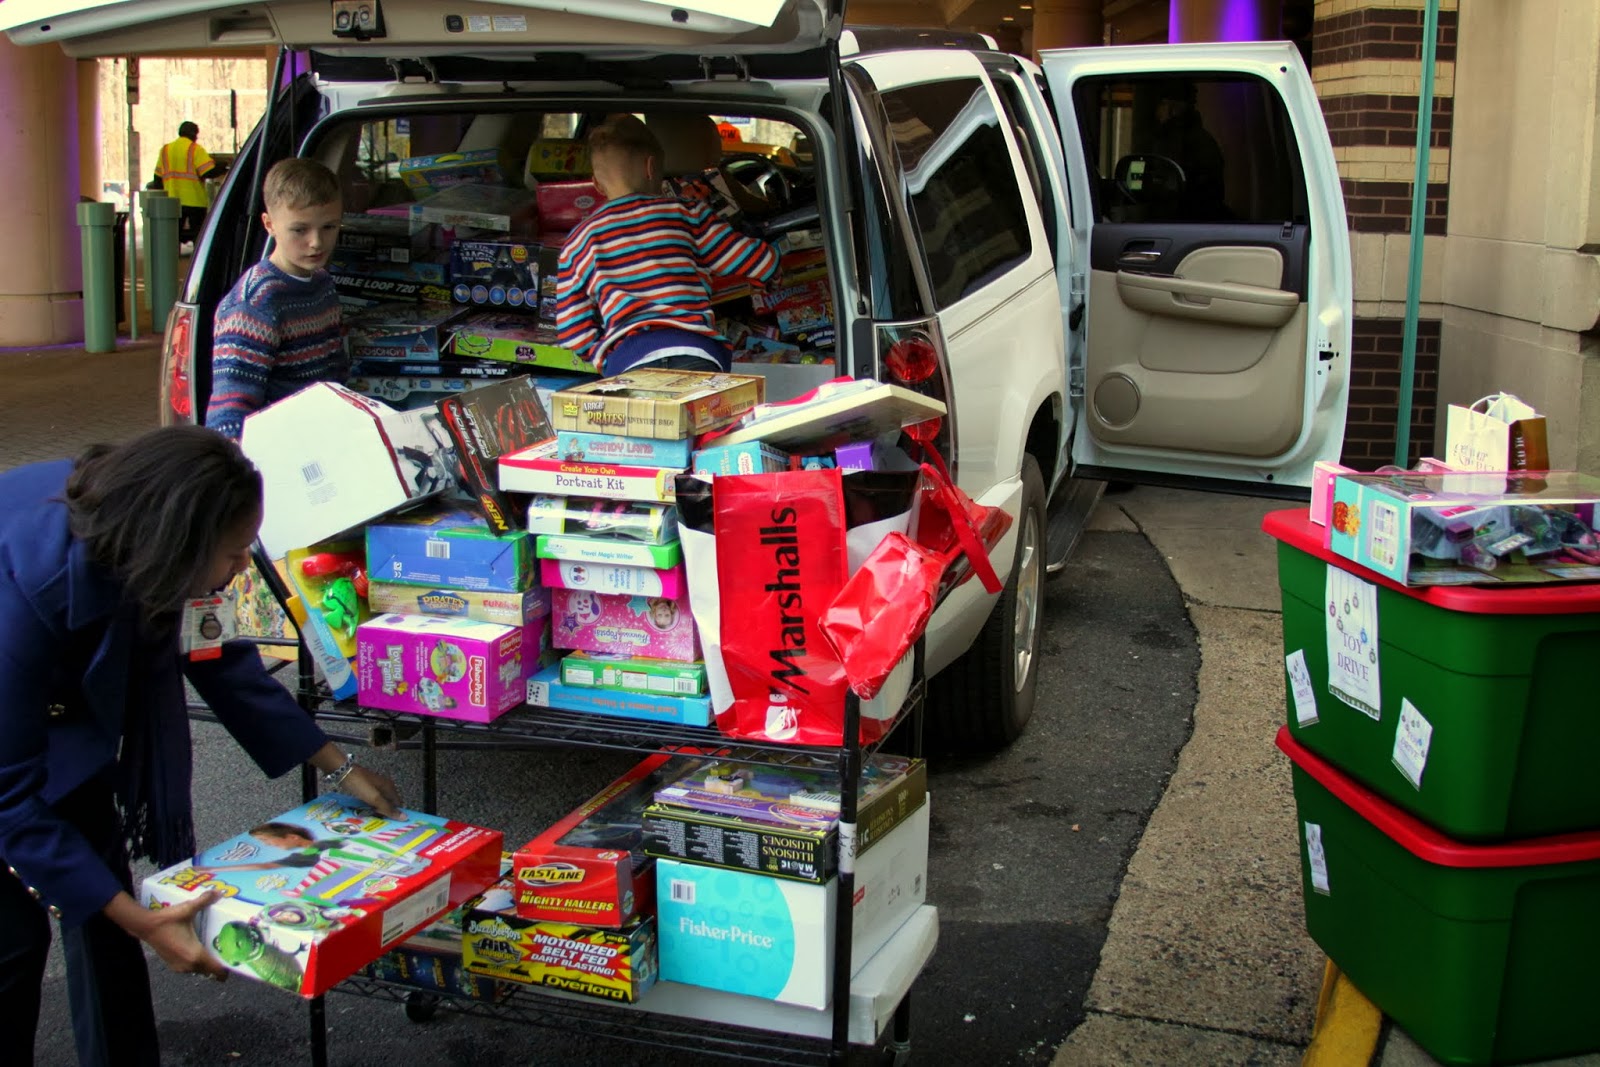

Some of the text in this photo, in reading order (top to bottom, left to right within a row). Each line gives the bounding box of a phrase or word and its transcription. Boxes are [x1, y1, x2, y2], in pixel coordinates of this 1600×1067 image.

[331, 274, 364, 287] OUBLE
[364, 279, 396, 292] LOOP
[396, 283, 416, 294] 720
[460, 367, 508, 376] STAR WARS
[586, 411, 627, 426] PIRATES!
[588, 440, 654, 455] CANDY LAND
[560, 464, 616, 475] Create Your Own
[555, 474, 625, 490] Portrait Kit
[481, 494, 510, 531] NERF
[581, 549, 634, 560] Travel Magic Writer
[421, 594, 466, 609] PIRATES
[759, 506, 810, 696] Marshalls
[1342, 632, 1363, 655] TOY
[389, 646, 402, 681] Loving
[1337, 651, 1369, 682] DRIVE
[377, 659, 395, 696] Family
[473, 658, 484, 704] Fisher-Price
[762, 846, 814, 862] ILLUSIONS
[158, 866, 199, 885] TOY
[781, 860, 813, 872] MAGIC
[202, 880, 240, 898] 3
[520, 895, 562, 907] MIGHTY
[564, 897, 615, 912] HAULERS
[679, 917, 773, 949] Fisher-Price
[533, 934, 618, 958] MOTORIZED
[541, 945, 608, 966] BELT FED
[530, 953, 616, 976] DART BLASTING!
[546, 975, 625, 1000] Overlord
